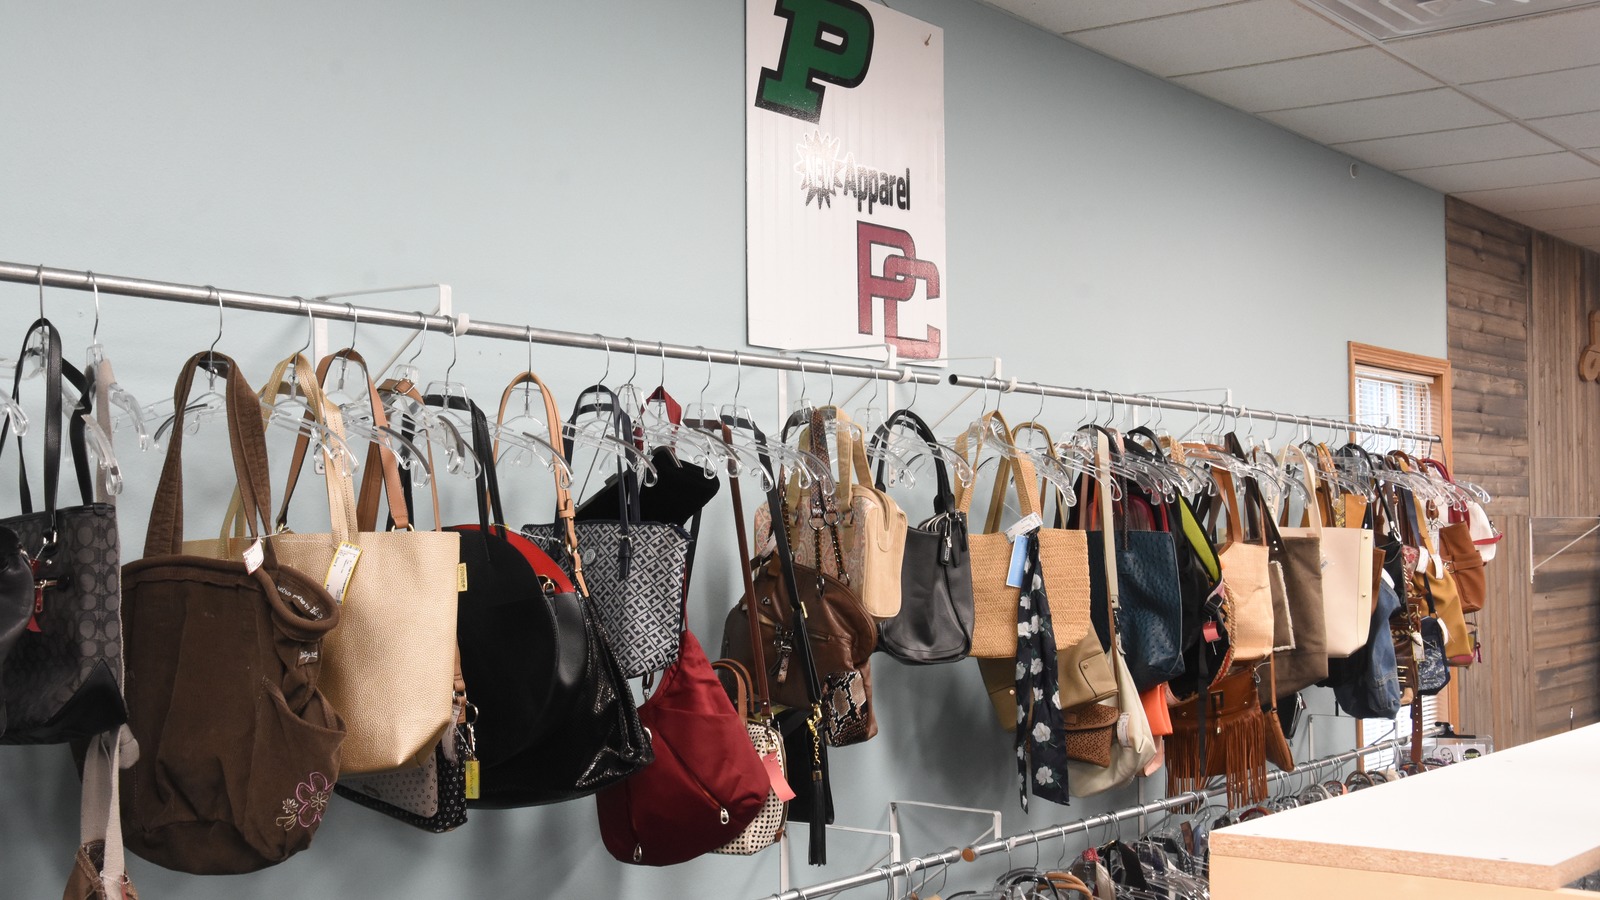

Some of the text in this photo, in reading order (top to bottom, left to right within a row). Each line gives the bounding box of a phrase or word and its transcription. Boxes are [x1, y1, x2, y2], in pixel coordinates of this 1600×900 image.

[755, 0, 874, 124] P
[804, 153, 911, 215] NEW Apparel
[856, 220, 941, 359] PC
